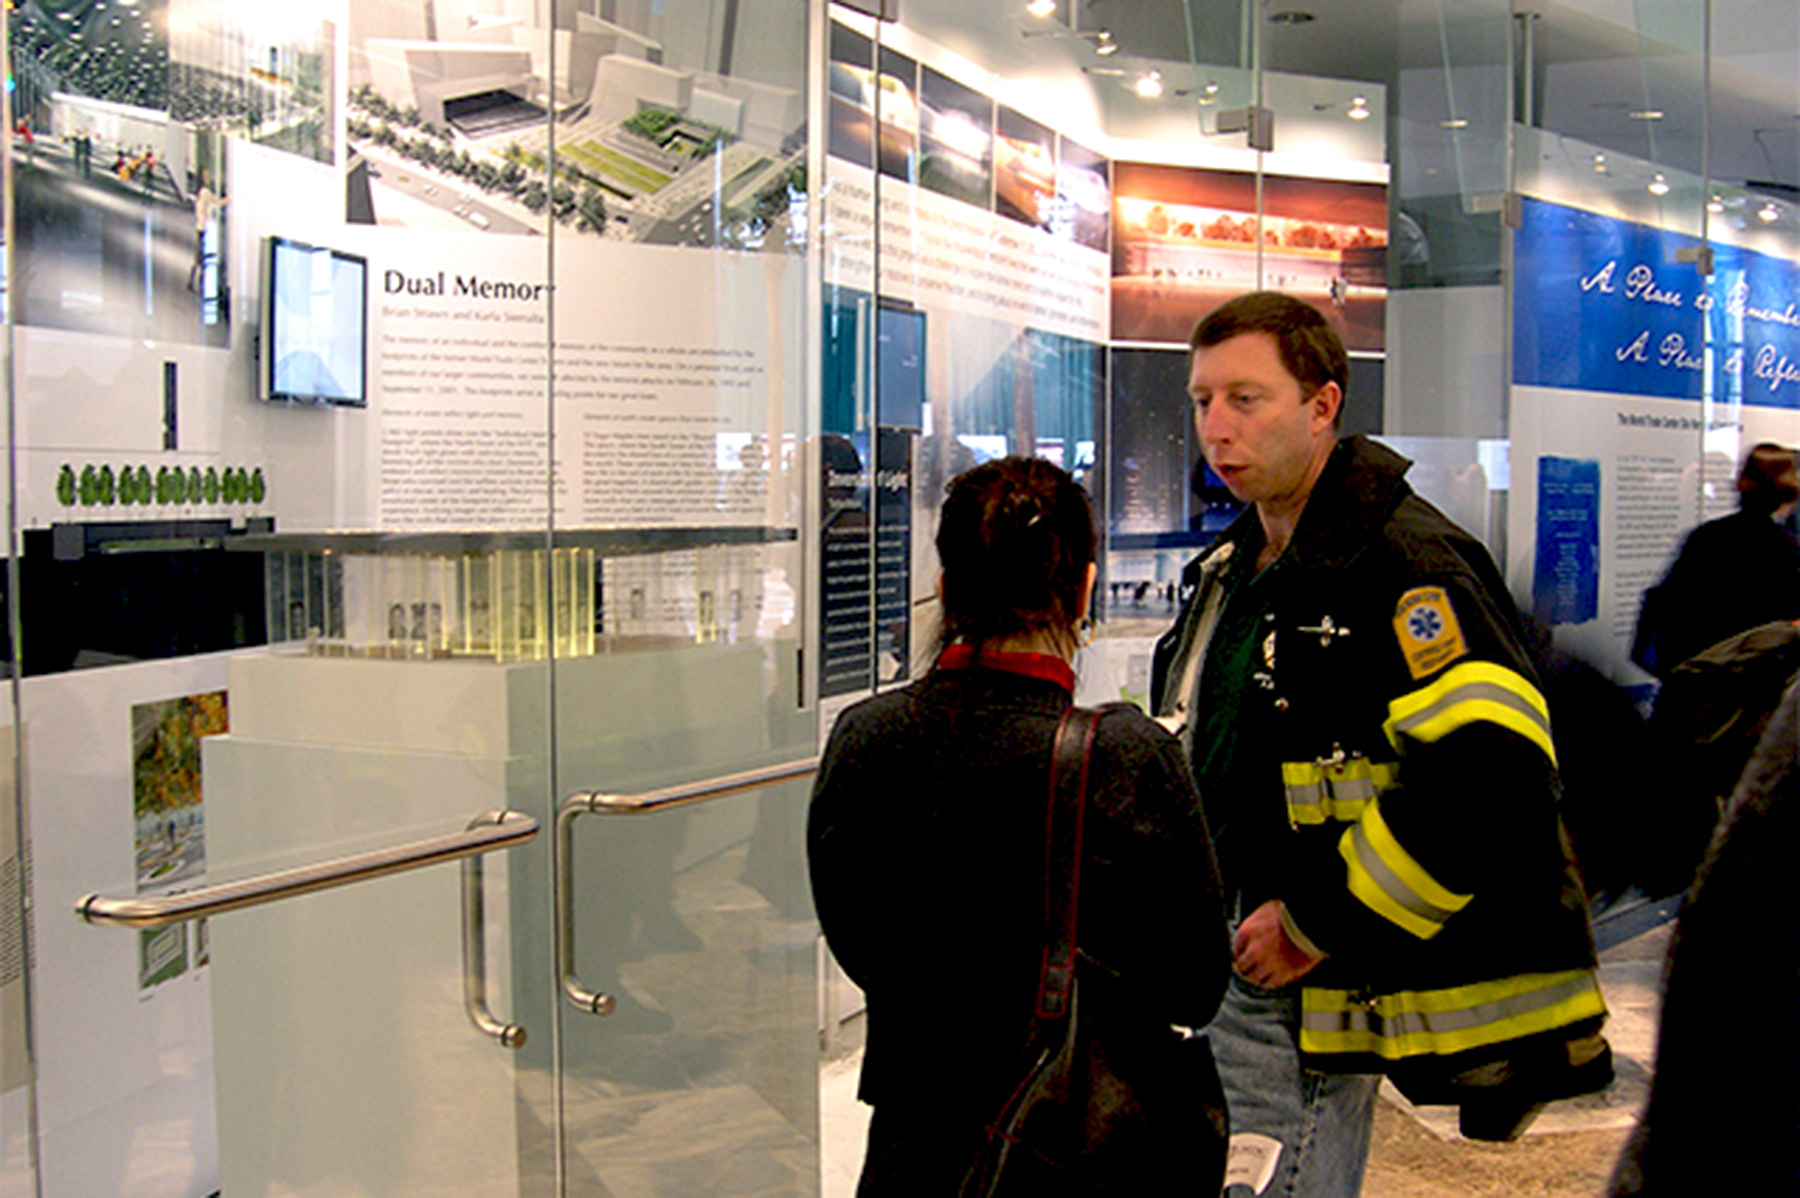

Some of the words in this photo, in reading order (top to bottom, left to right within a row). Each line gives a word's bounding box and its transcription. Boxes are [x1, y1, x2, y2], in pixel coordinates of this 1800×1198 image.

[383, 269, 445, 296] Dual
[1580, 260, 1617, 293] A
[1625, 264, 1683, 307] Place
[1726, 278, 1800, 327] Remembe
[453, 308, 472, 320] and
[1616, 330, 1649, 362] A
[1659, 332, 1704, 370] Plac
[1754, 343, 1800, 391] Refle
